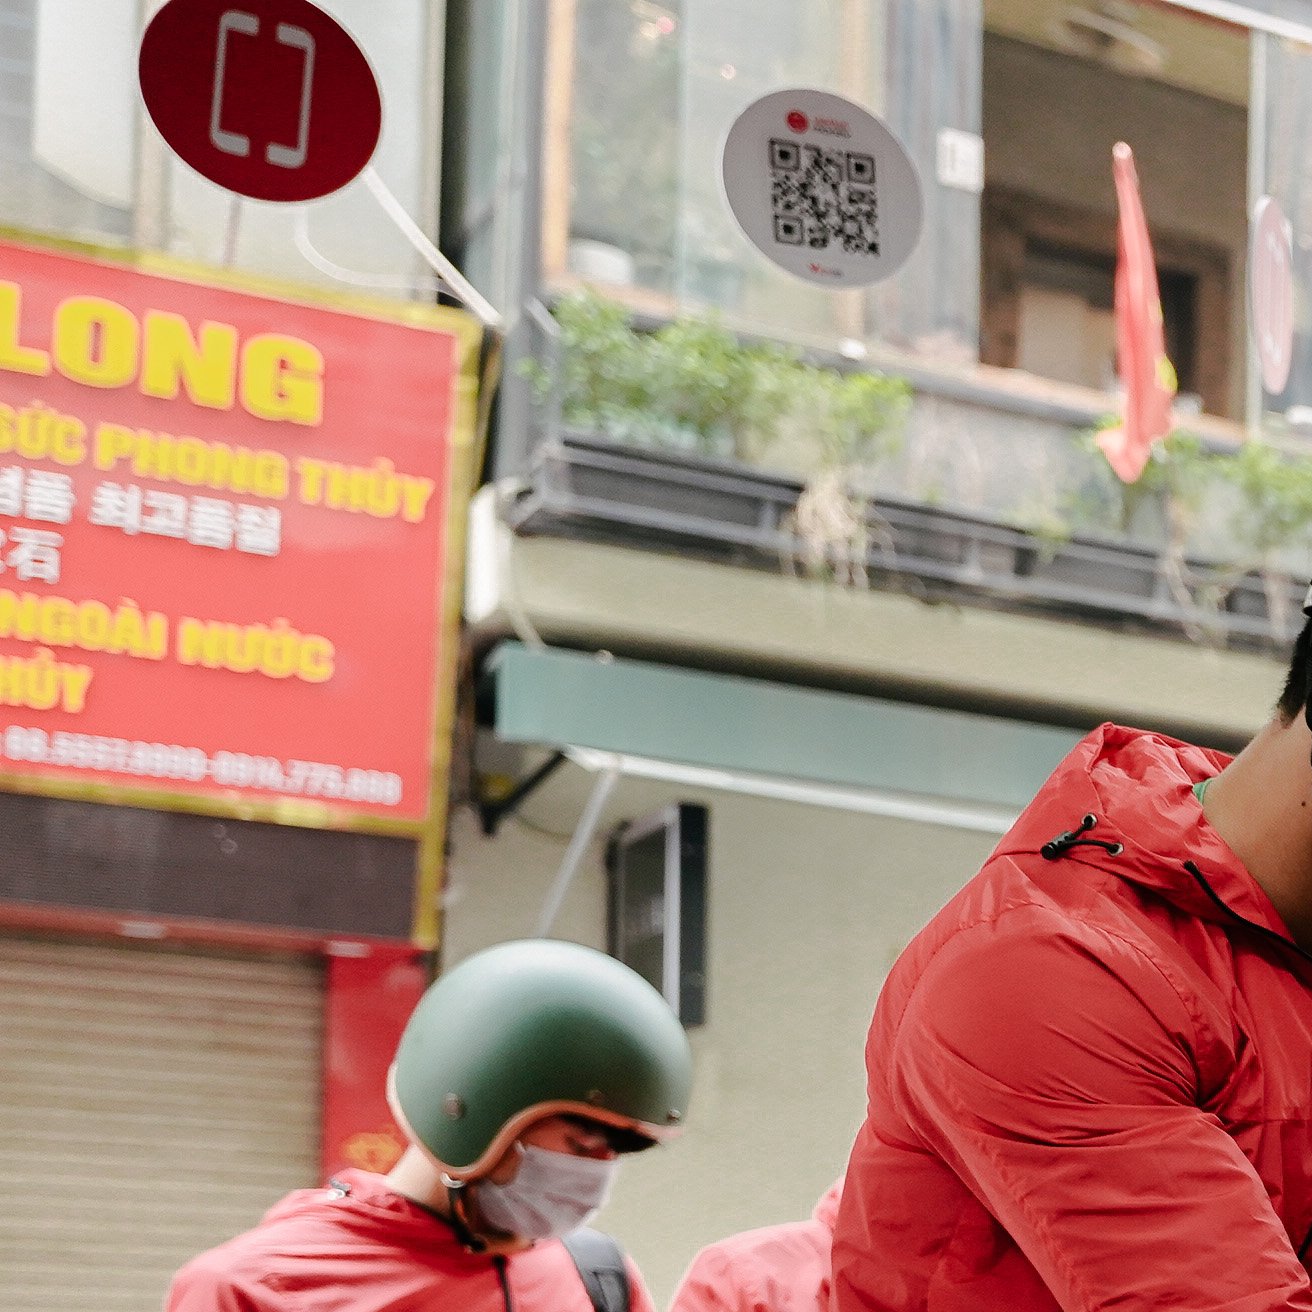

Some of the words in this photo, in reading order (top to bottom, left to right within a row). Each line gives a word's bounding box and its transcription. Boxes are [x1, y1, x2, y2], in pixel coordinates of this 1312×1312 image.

[0, 280, 323, 425] LONG
[94, 422, 288, 498] PHONG
[297, 455, 434, 523] THỦY
[178, 614, 334, 683] NƯỚC
